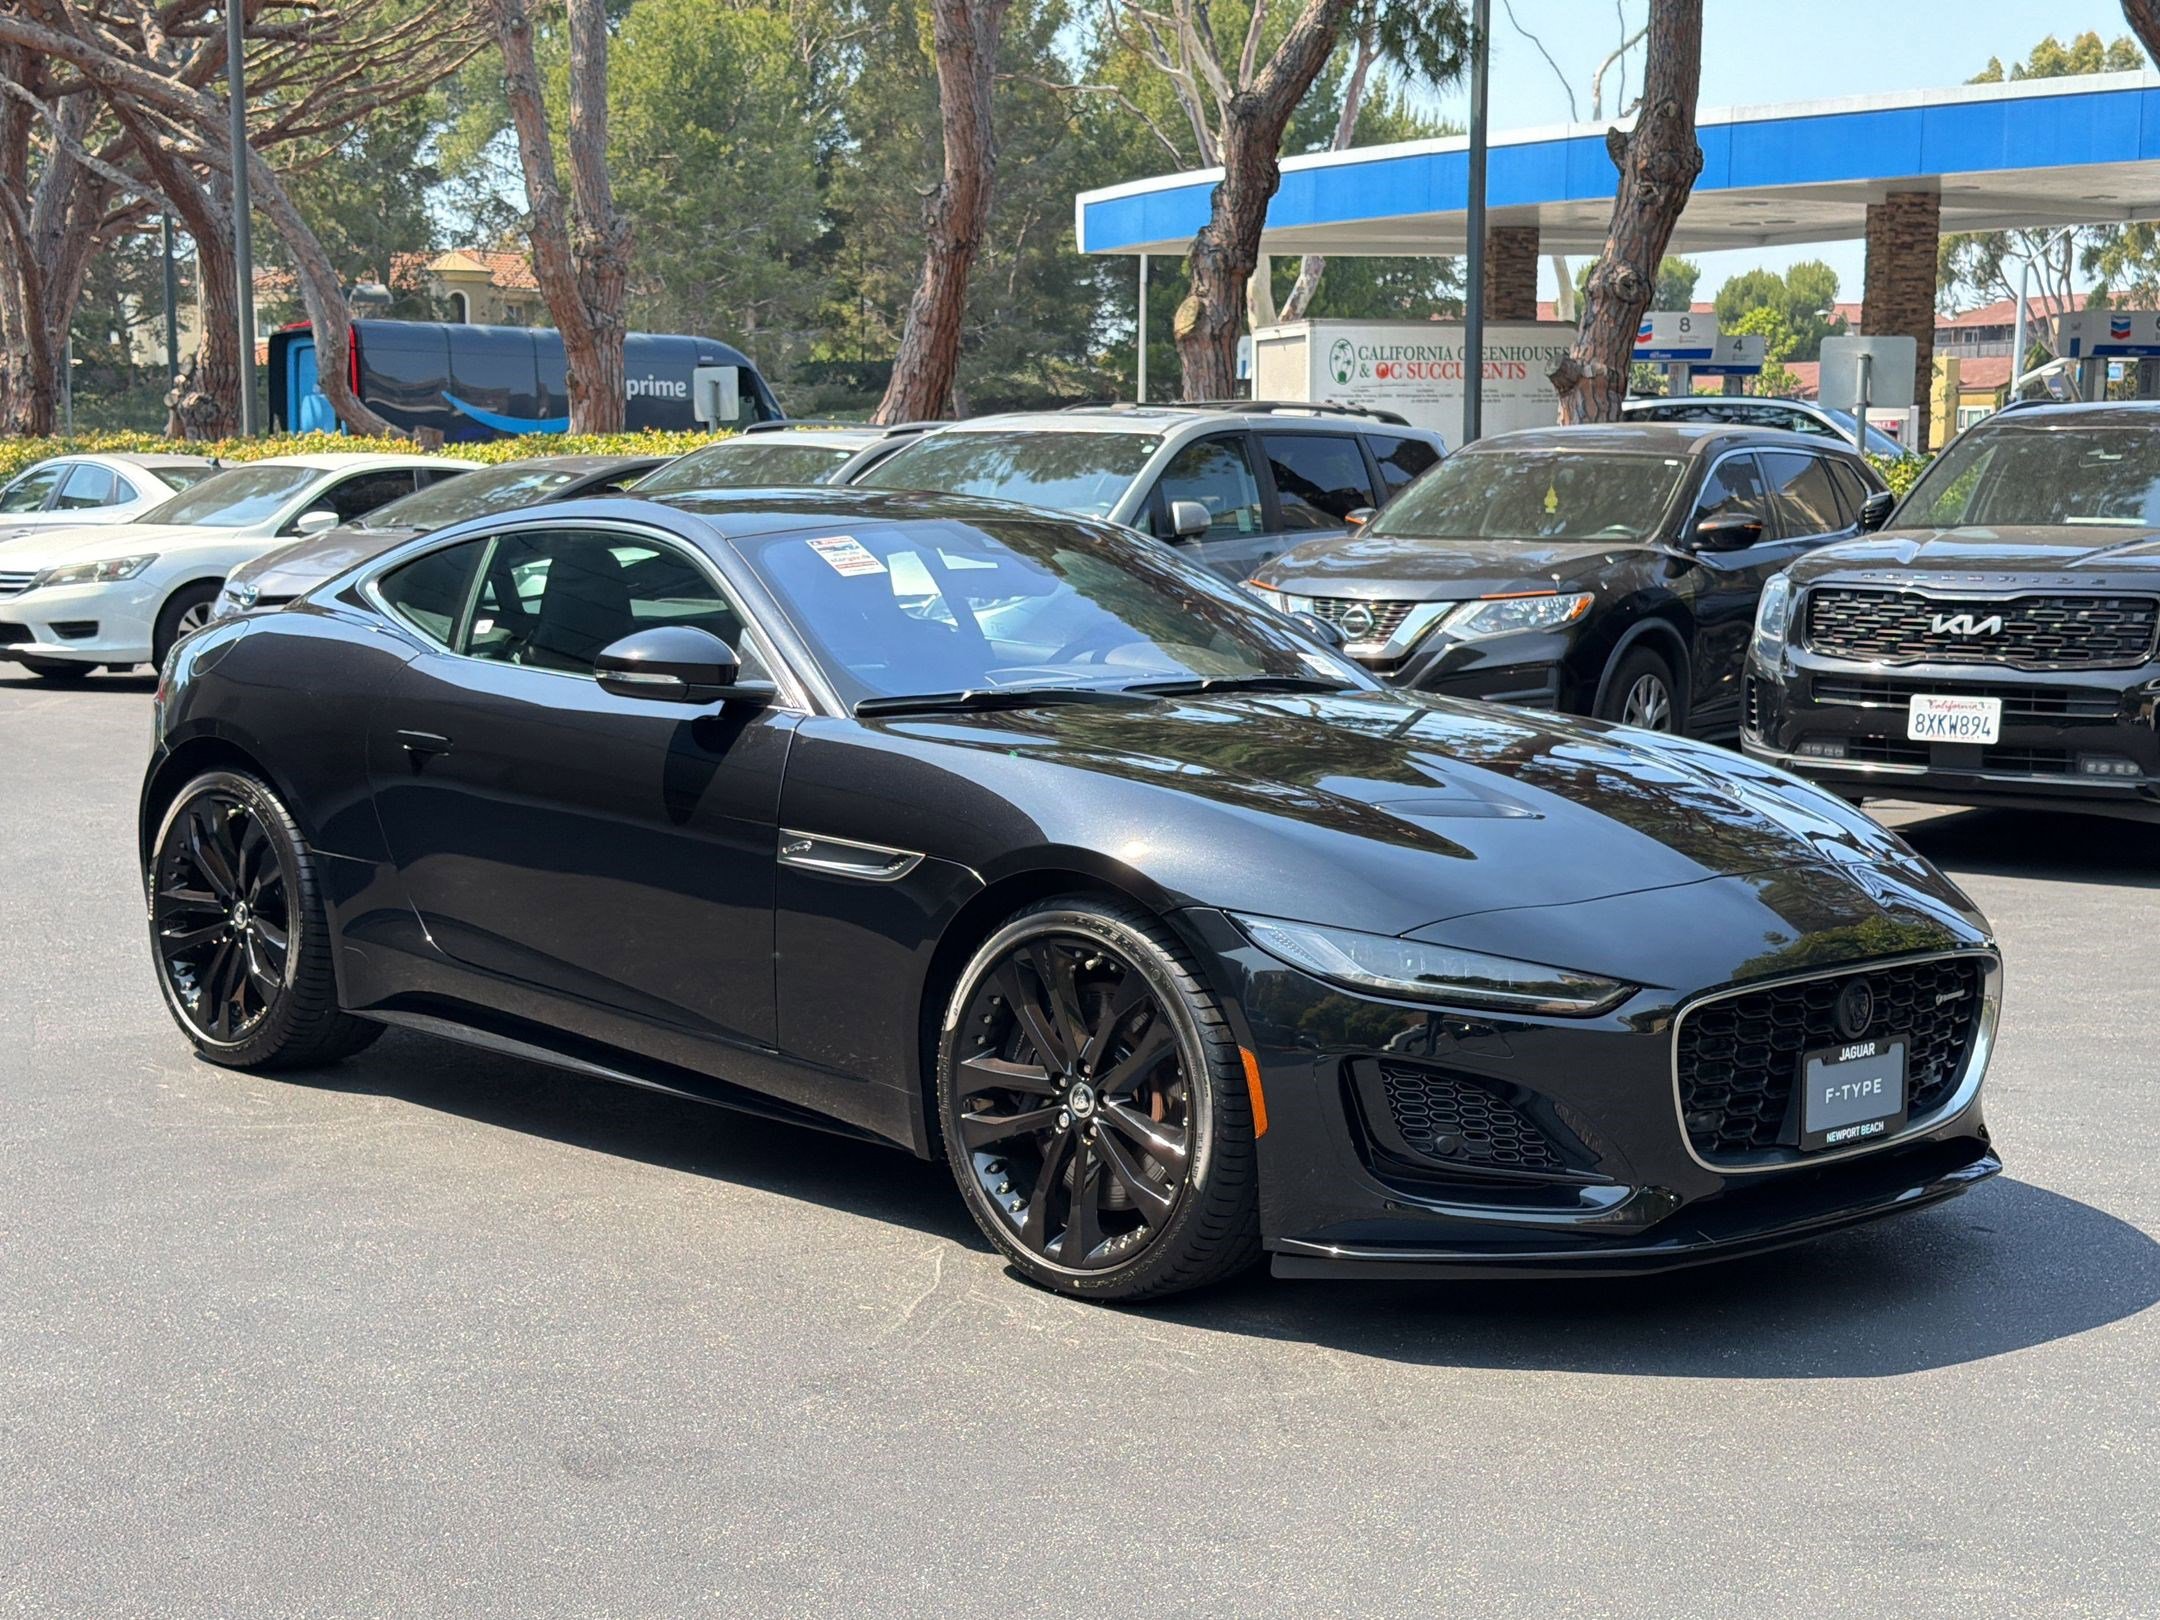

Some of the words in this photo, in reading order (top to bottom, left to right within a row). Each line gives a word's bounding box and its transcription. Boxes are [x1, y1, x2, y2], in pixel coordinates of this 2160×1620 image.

[1679, 317, 1691, 333] 8
[1358, 345, 1453, 361] CALIFORNIA
[1733, 339, 1744, 352] 4
[1359, 363, 1371, 378] &
[1375, 362, 1402, 380] OC
[1406, 362, 1526, 380] SUCCUENTS
[626, 374, 687, 401] prime
[1915, 713, 1991, 737] 8XKW894
[1838, 1042, 1876, 1062] JAGUAR
[1825, 1078, 1882, 1104] F-TYPE
[1826, 1126, 1860, 1143] NEWPORT
[1860, 1120, 1885, 1135] BEACH
